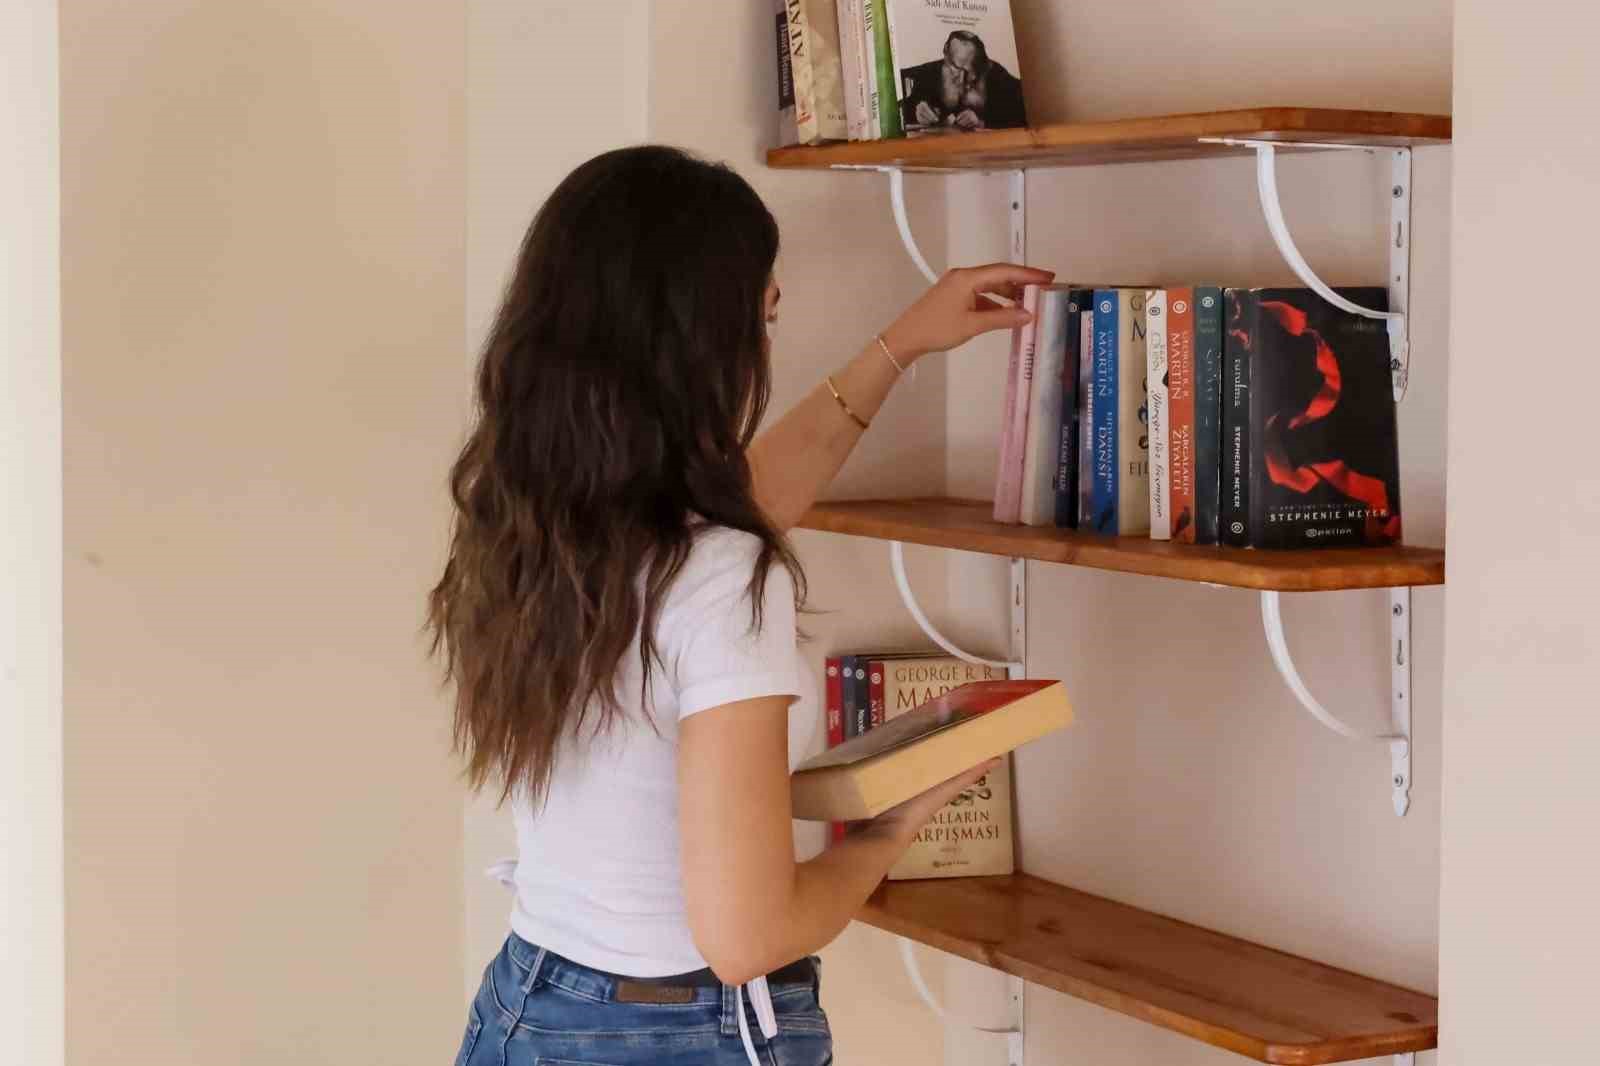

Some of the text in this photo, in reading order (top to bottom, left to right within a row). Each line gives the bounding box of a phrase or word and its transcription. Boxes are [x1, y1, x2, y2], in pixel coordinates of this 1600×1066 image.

[1098, 331, 1107, 397] MARTIN
[1171, 333, 1181, 400] MARTIN
[1269, 509, 1388, 522] STEPHENIE MEYER
[895, 665, 959, 682] GEORGE
[911, 824, 999, 845] ARPIŞMASI
